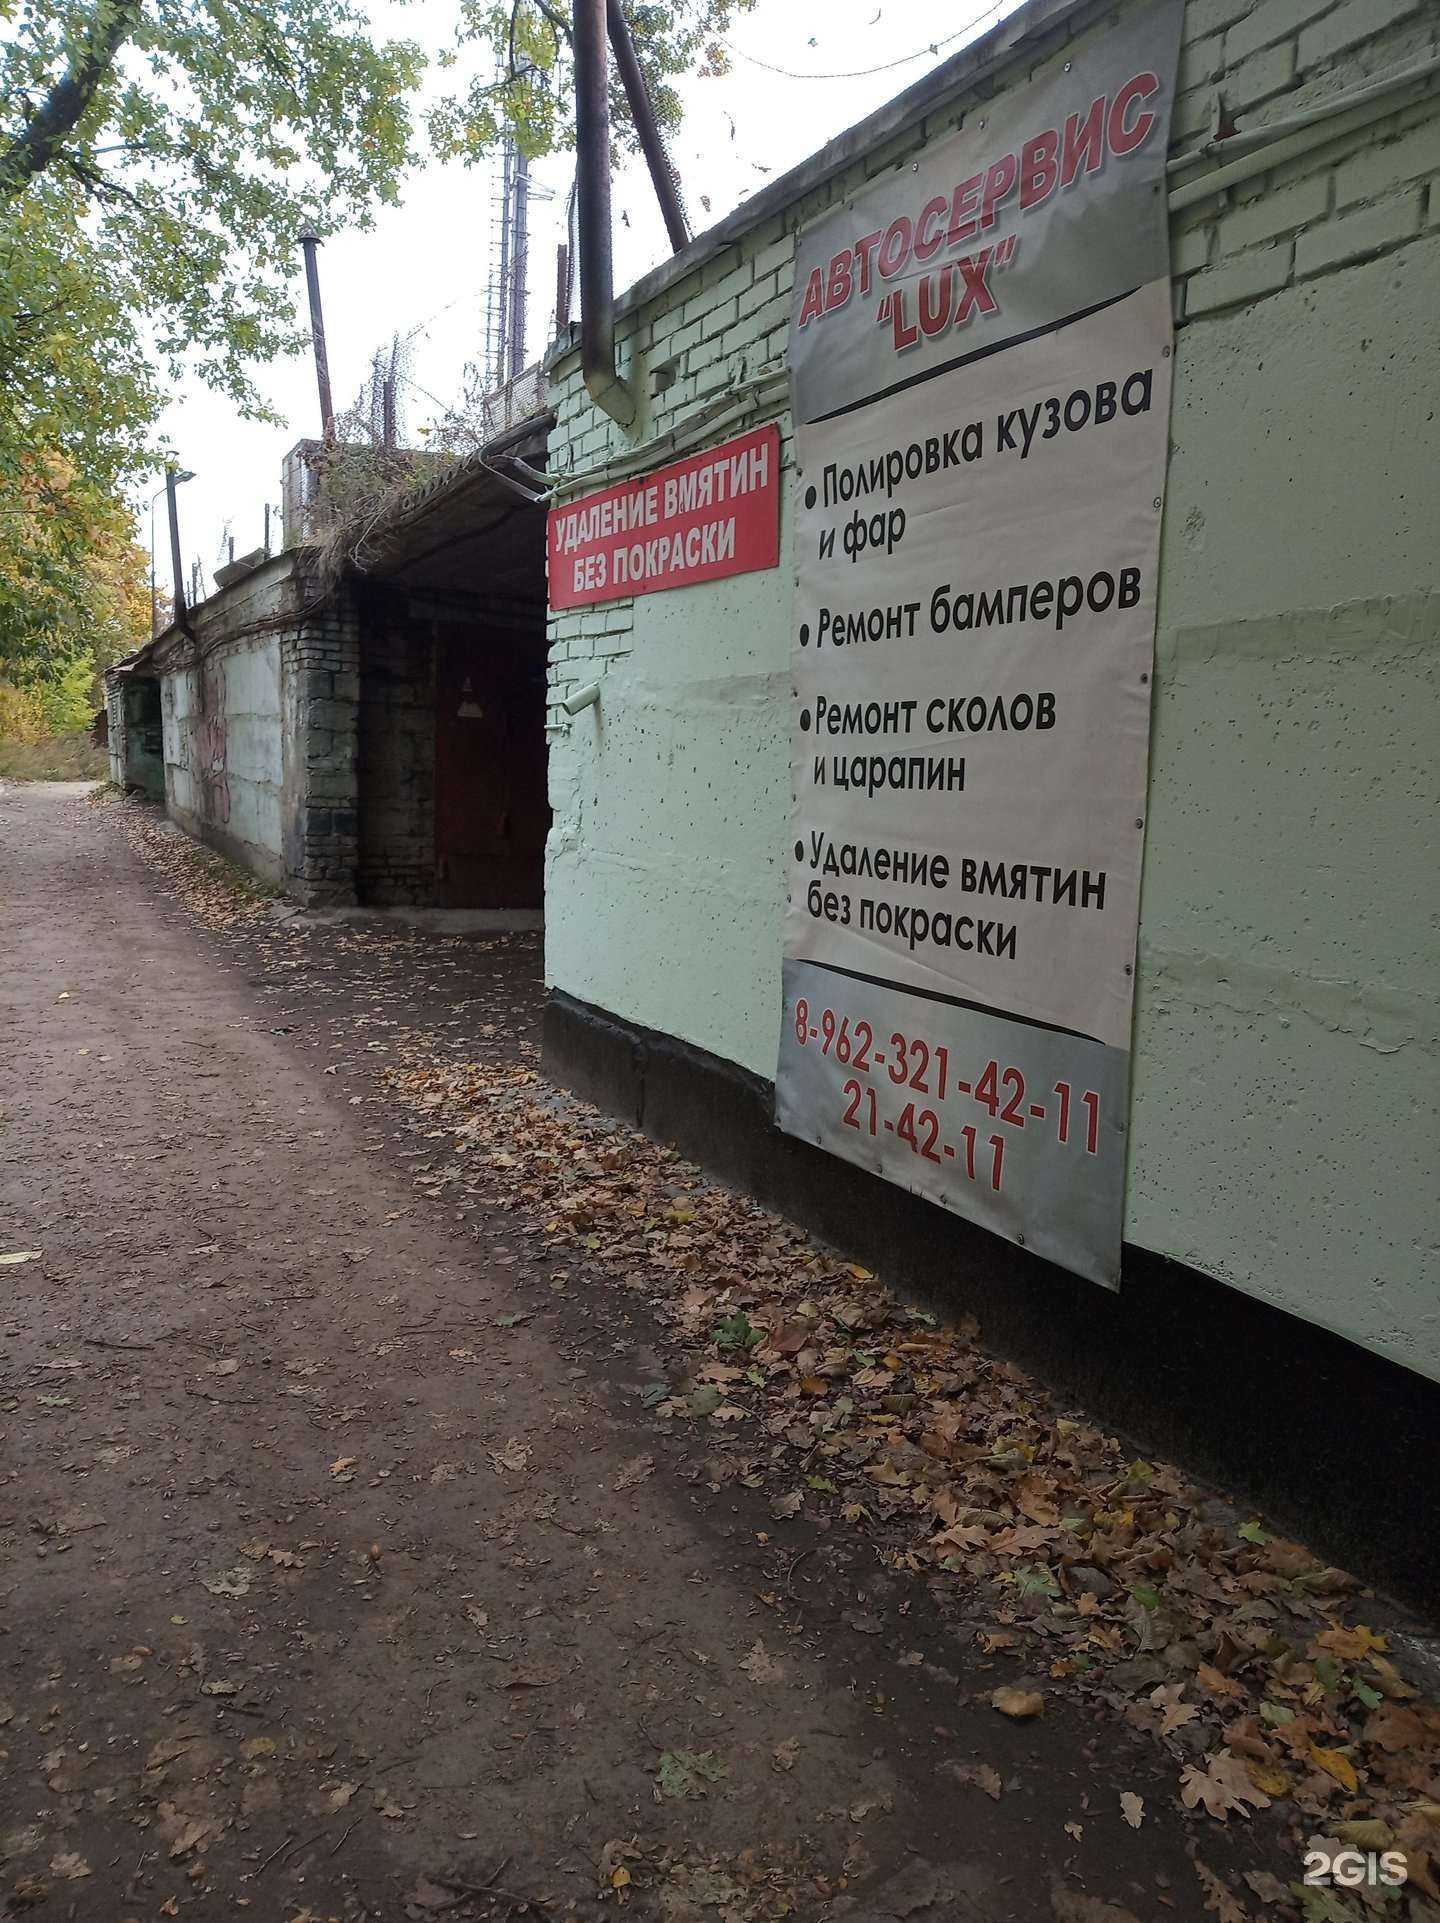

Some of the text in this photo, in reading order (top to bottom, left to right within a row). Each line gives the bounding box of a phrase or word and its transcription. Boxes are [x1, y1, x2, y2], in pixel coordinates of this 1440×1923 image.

[798, 72, 1160, 327] АВТОСЕРВИС
[823, 369, 1153, 508] Полировка кузова
[555, 443, 769, 555] УДАЛЕНИЕ ВМЯТИН
[819, 507, 906, 563] и фар
[573, 517, 736, 593] БЕЗ ПОКРАСКИ
[817, 566, 1141, 648] Ремонт бамперов
[815, 692, 1056, 735] Ремонт сколов
[814, 756, 966, 798] и царапин
[810, 831, 1106, 910] Удаление вмятин
[807, 880, 1017, 960] без покраски
[795, 998, 1100, 1155] 8-962-321-42-11
[842, 1078, 1006, 1192] 21-42-11
